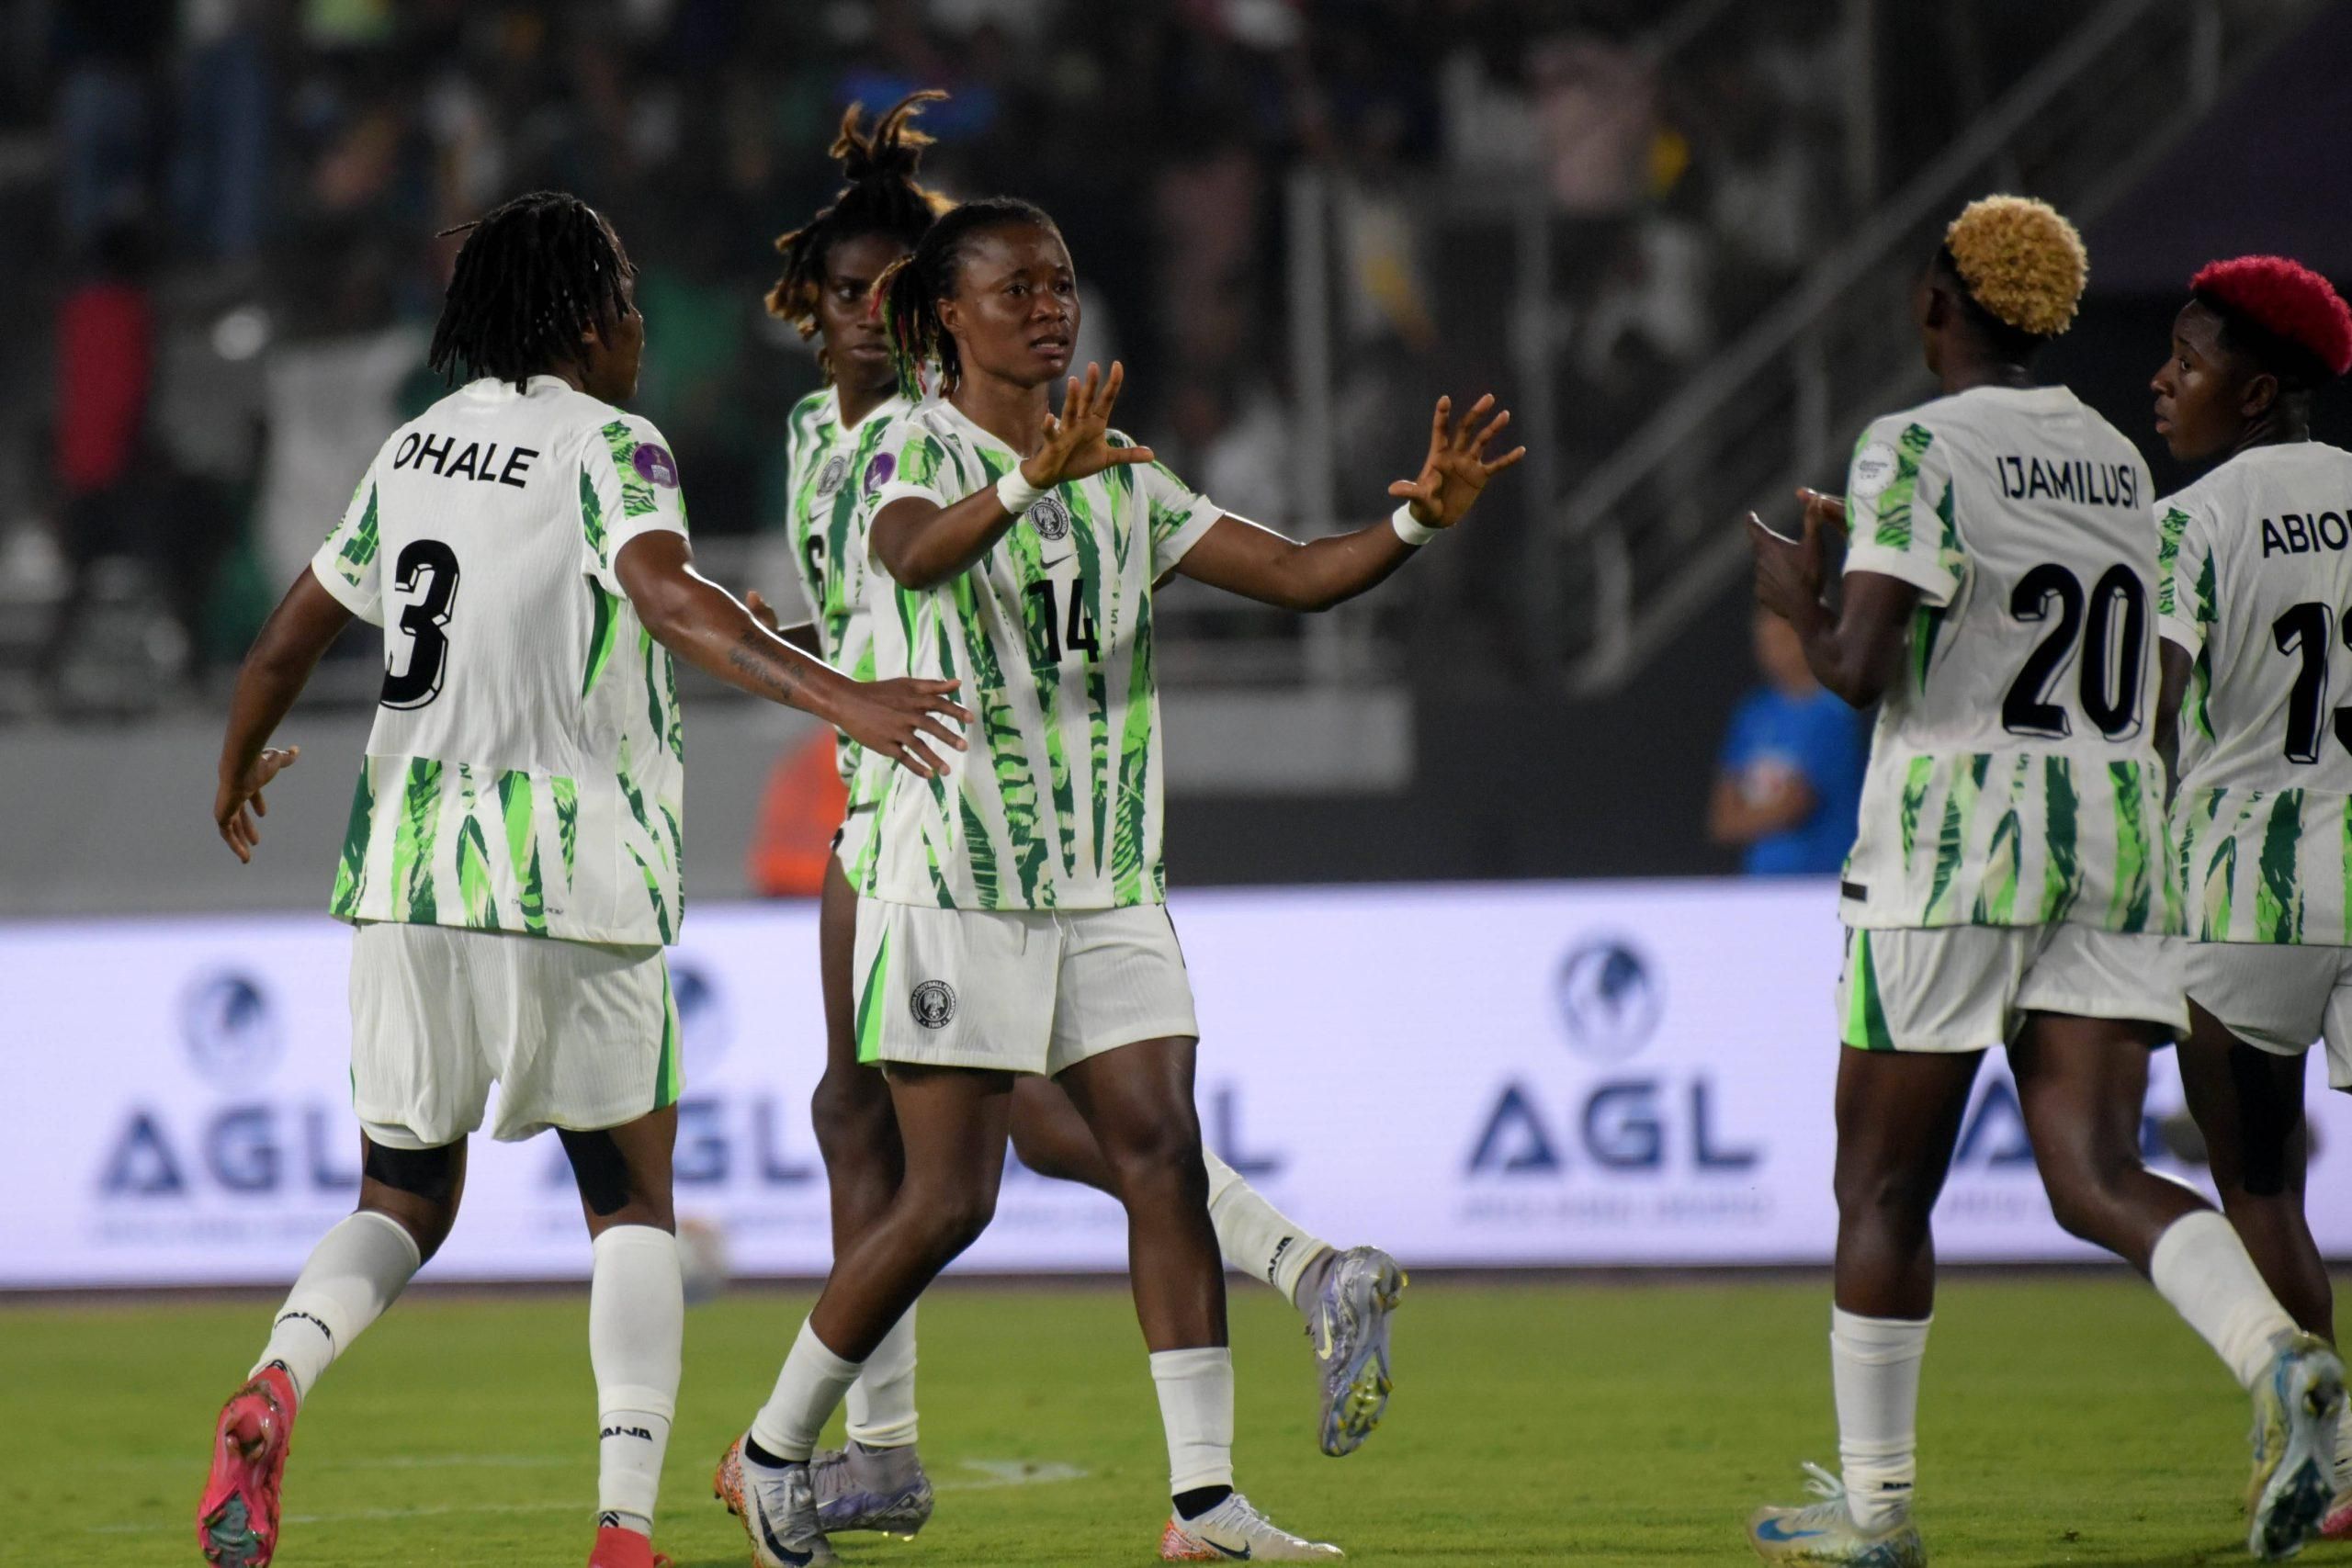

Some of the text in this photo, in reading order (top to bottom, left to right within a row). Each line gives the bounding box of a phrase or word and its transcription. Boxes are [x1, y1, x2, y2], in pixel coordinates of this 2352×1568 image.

[393, 433, 539, 489] OHALE
[1996, 456, 2140, 510] IJAMILUSI
[2262, 510, 2352, 558] ABIO
[379, 539, 459, 711] 3
[1027, 578, 1101, 663] 14
[2002, 563, 2149, 742] 20
[1469, 1078, 1761, 1174] AGL
